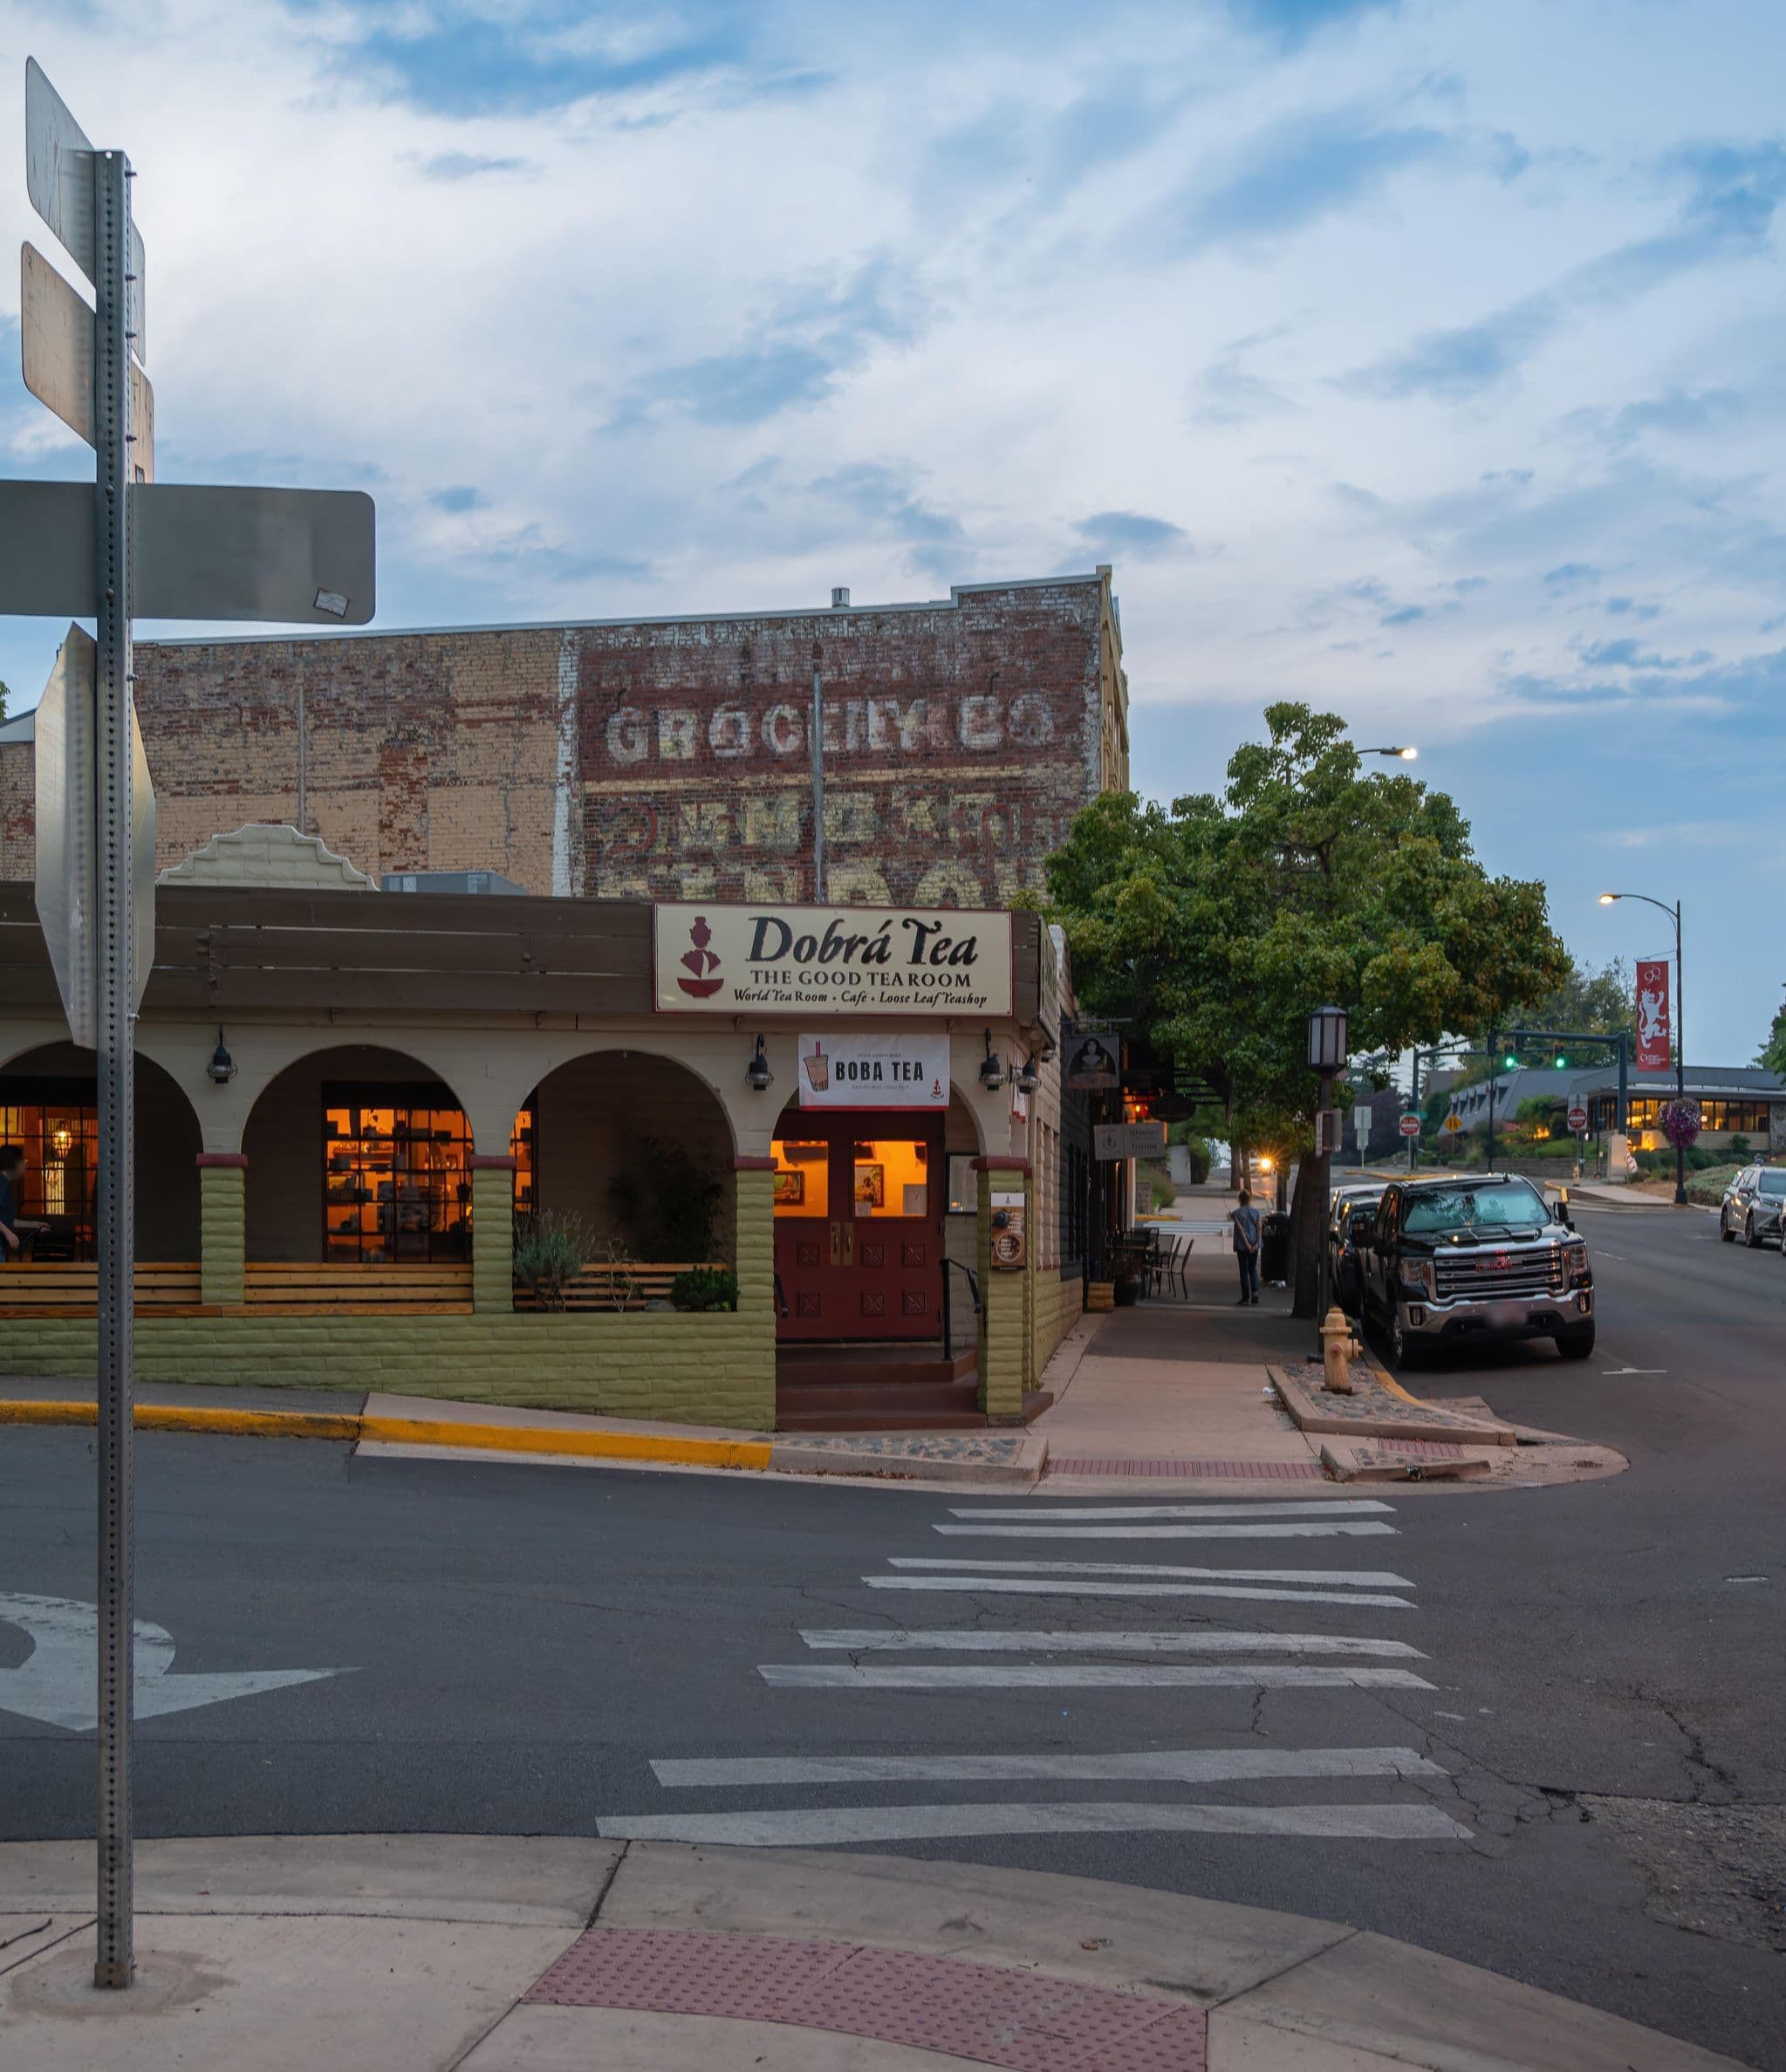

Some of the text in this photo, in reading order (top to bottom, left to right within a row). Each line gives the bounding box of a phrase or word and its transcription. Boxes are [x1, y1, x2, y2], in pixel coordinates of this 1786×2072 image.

[745, 916, 979, 966] Dobrá Tea
[750, 970, 791, 985] THE
[798, 971, 861, 986] GOOD
[734, 988, 770, 1002] World
[772, 988, 792, 1002] Tea
[796, 990, 828, 1002] Room
[879, 991, 911, 1003] Loose
[914, 991, 943, 1008] Leaf
[942, 991, 988, 1008] Teashop
[836, 1061, 924, 1081] BOBA TEA
